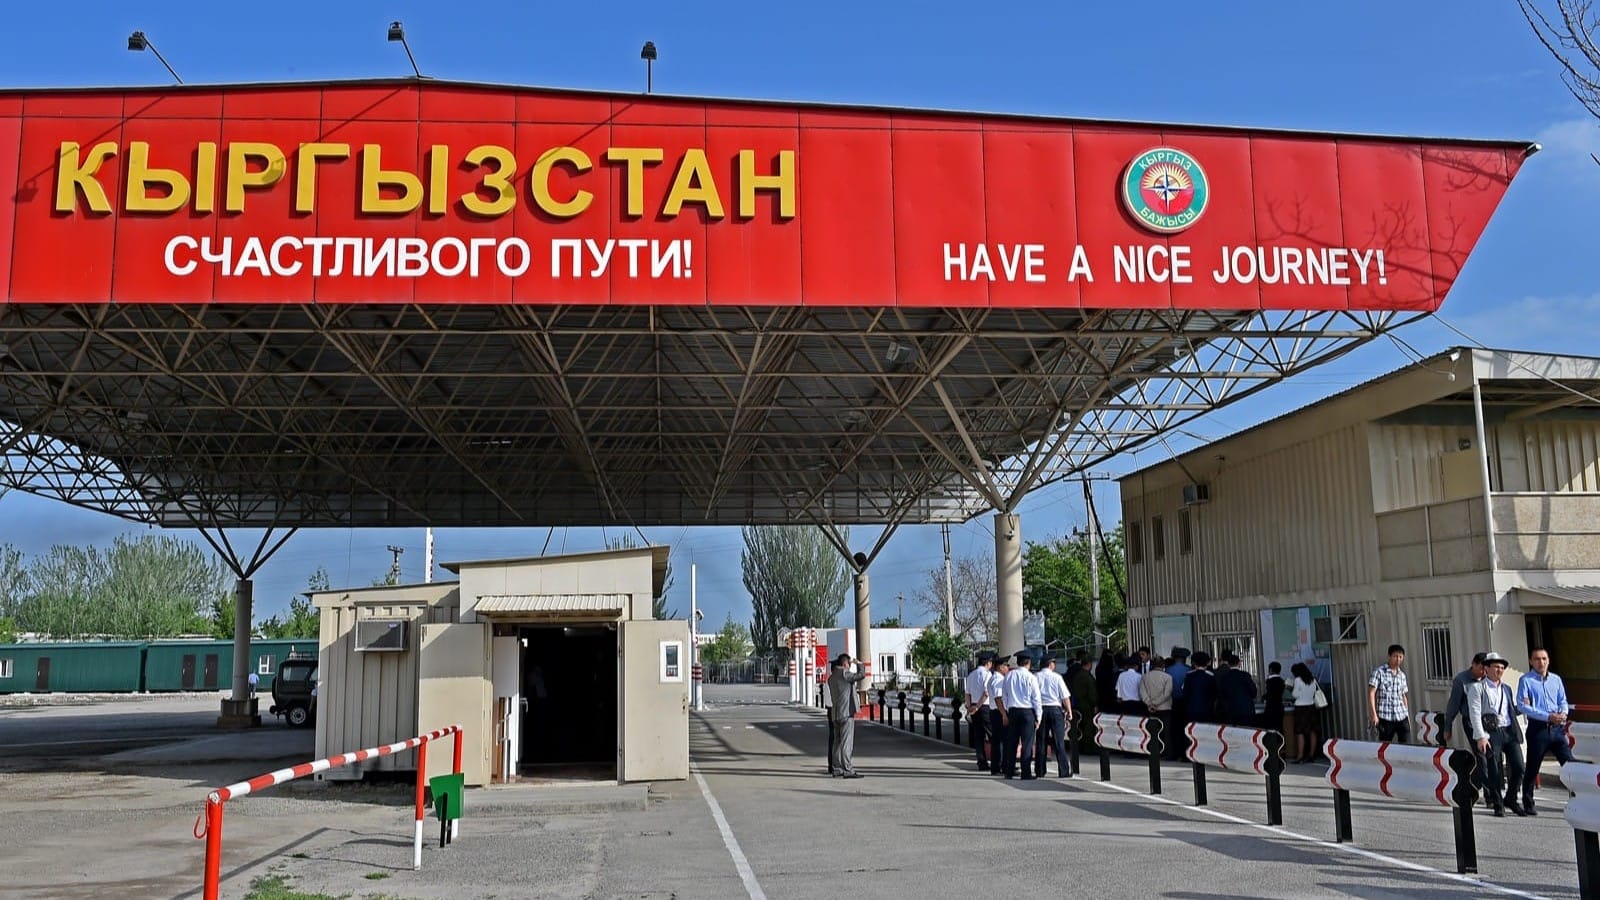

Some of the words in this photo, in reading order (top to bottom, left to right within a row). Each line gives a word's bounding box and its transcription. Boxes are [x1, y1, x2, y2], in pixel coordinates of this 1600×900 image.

[56, 141, 796, 218] КЫРГЫЗСТАН
[1139, 152, 1192, 170] КЫРГЫЗ
[1140, 207, 1196, 226] БАЖЫСЫ
[164, 235, 531, 278] СЧАСТЛИВОГО
[551, 238, 693, 279] ПУТИ!
[943, 243, 1046, 282] HAVE
[1067, 244, 1094, 283] A
[1113, 245, 1193, 284] NICE
[1212, 246, 1388, 286] JOURNEY!
